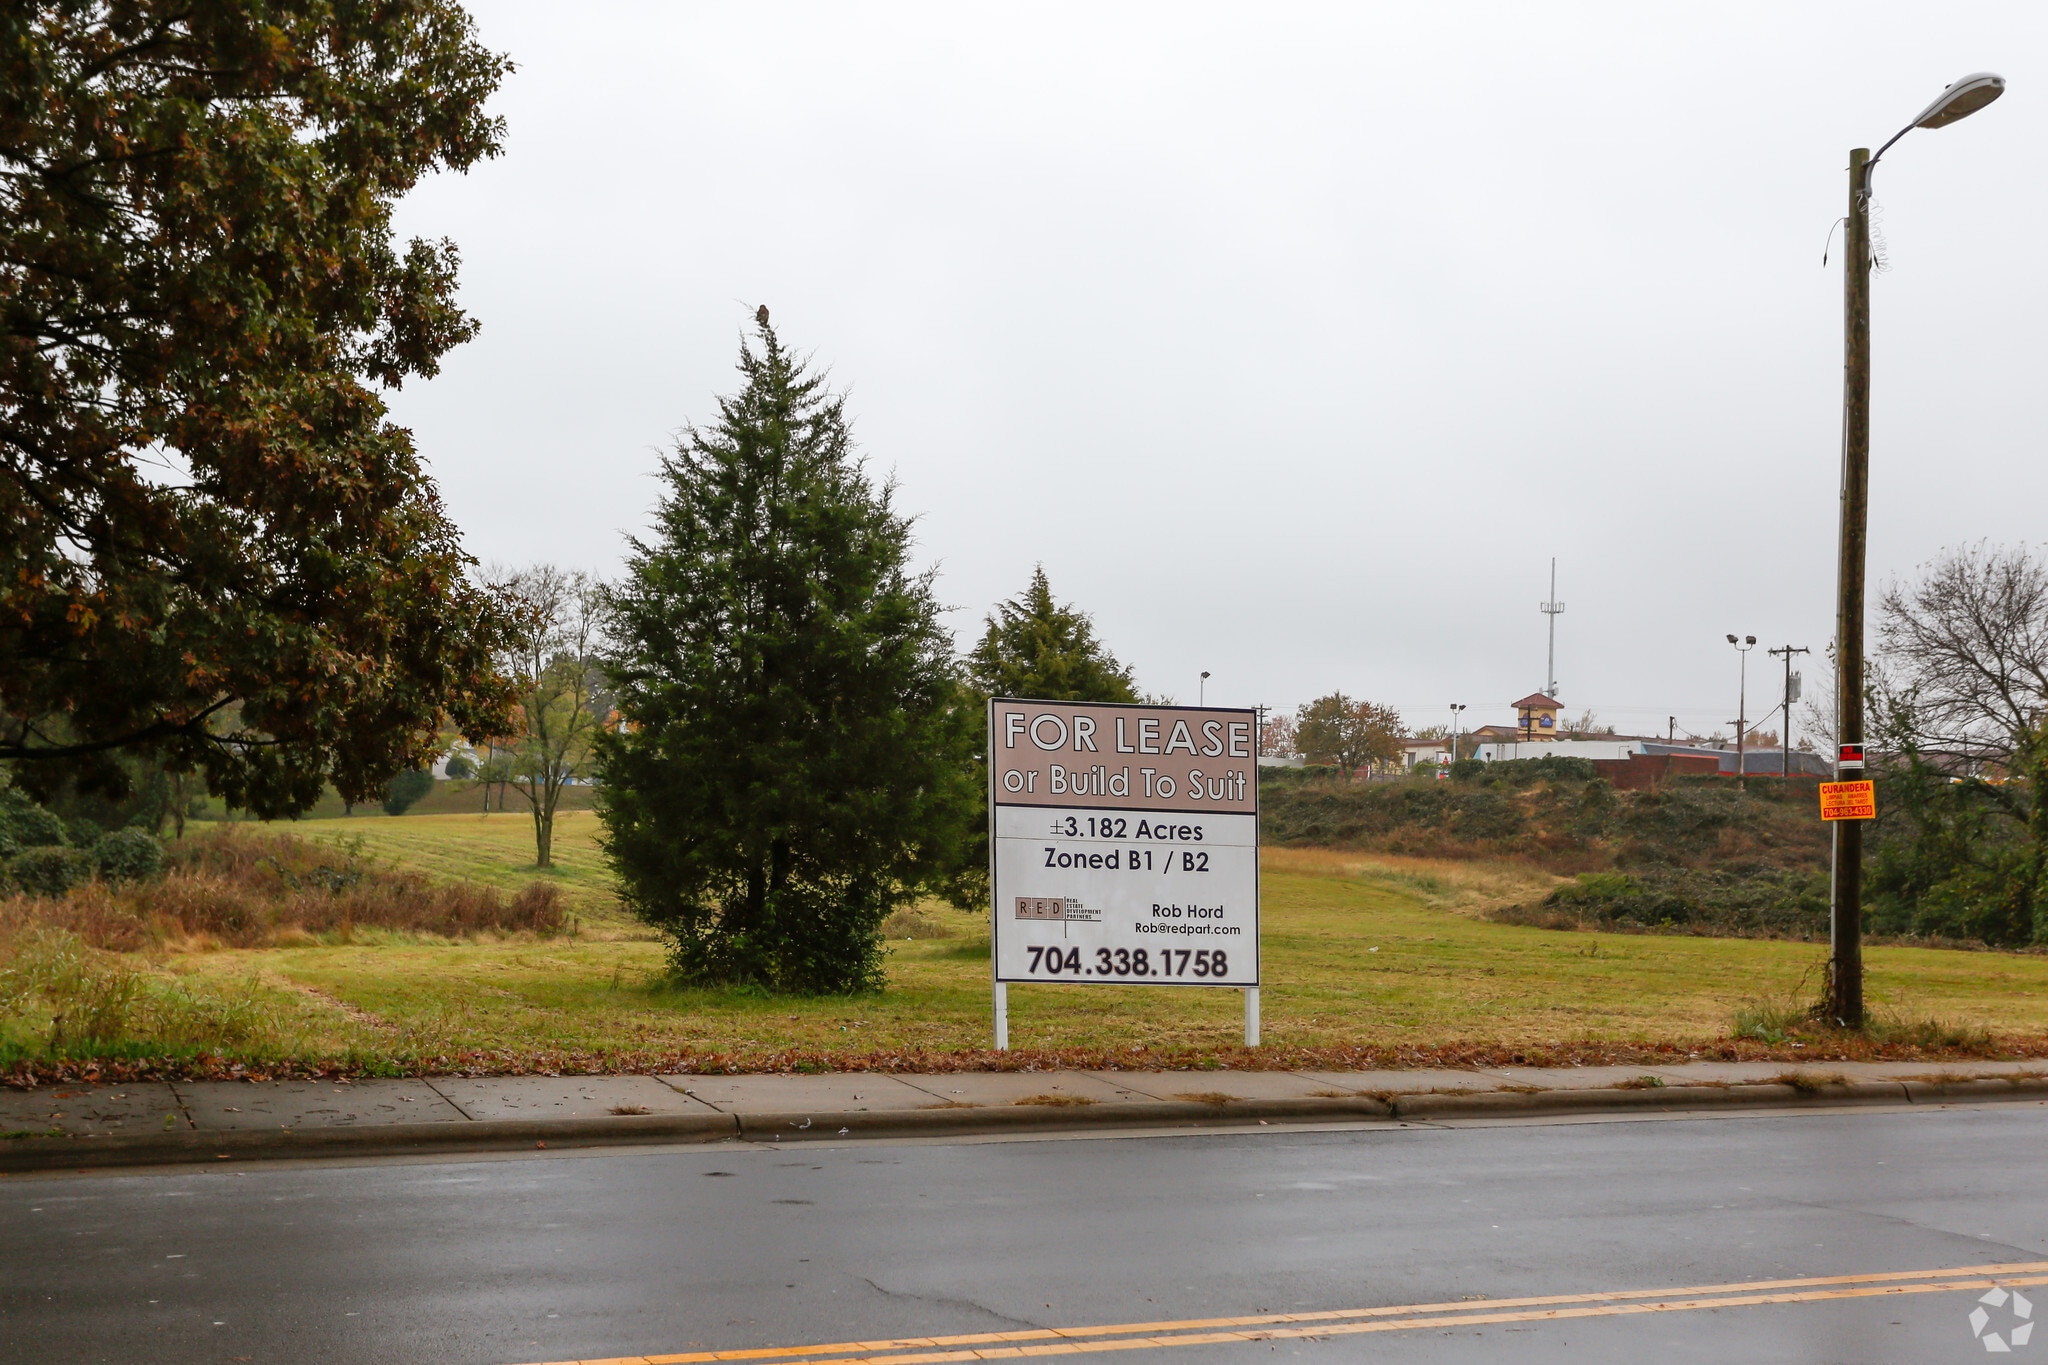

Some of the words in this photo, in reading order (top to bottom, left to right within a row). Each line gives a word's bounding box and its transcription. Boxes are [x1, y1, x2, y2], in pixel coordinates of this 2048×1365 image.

[1005, 712, 1098, 752] FOR
[1115, 717, 1249, 758] LEASE
[1003, 769, 1039, 793] or
[1050, 764, 1130, 797] Build
[1140, 768, 1177, 798] To
[1188, 769, 1247, 801] Suit
[1822, 783, 1870, 794] CURANDERA
[1050, 816, 1127, 839] ±3.182
[1135, 819, 1204, 841] Acres
[1044, 847, 1120, 870] Zoned
[1129, 850, 1152, 871] B1
[1163, 851, 1174, 874] /
[1182, 852, 1209, 872] B2
[1152, 904, 1182, 918] Rob
[1187, 905, 1223, 919] Hord
[1135, 922, 1241, 936] Rob@redpart.com
[1026, 945, 1228, 977] 704.338.1758
